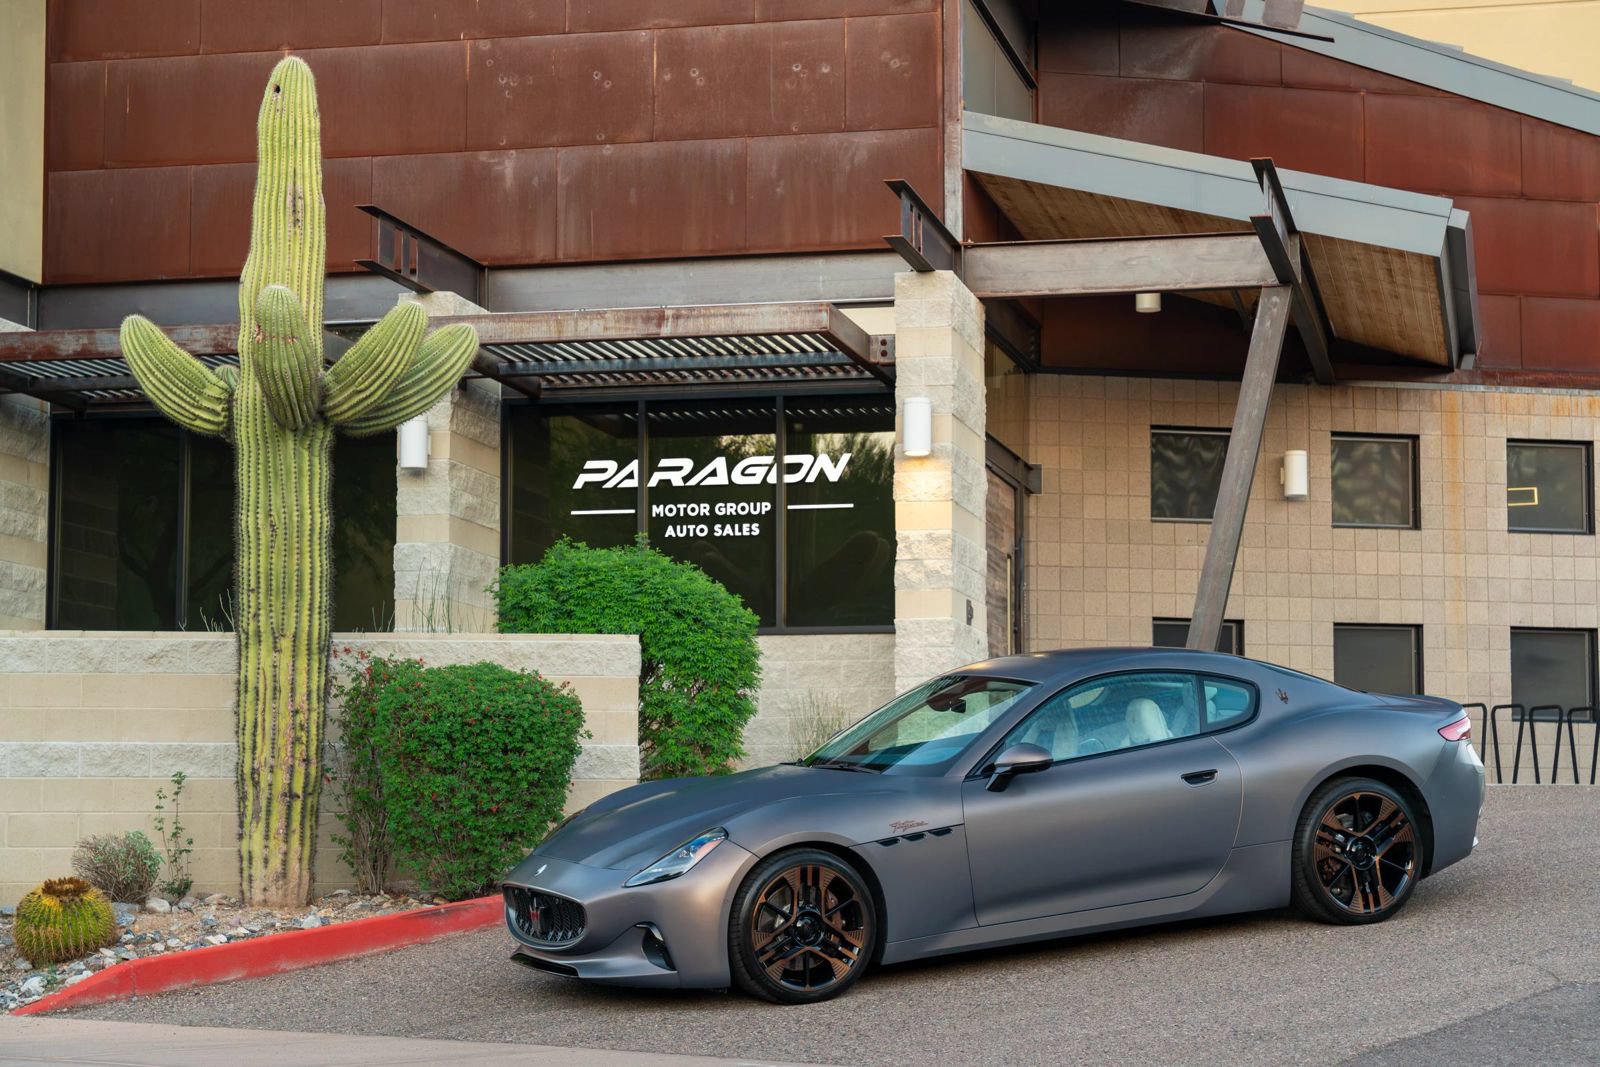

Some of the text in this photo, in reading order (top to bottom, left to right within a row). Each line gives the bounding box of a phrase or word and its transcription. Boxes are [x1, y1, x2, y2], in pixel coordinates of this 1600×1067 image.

[572, 453, 852, 490] PARAGON
[651, 501, 772, 518] MOTOR GROUP
[664, 522, 760, 538] AUTO SALES
